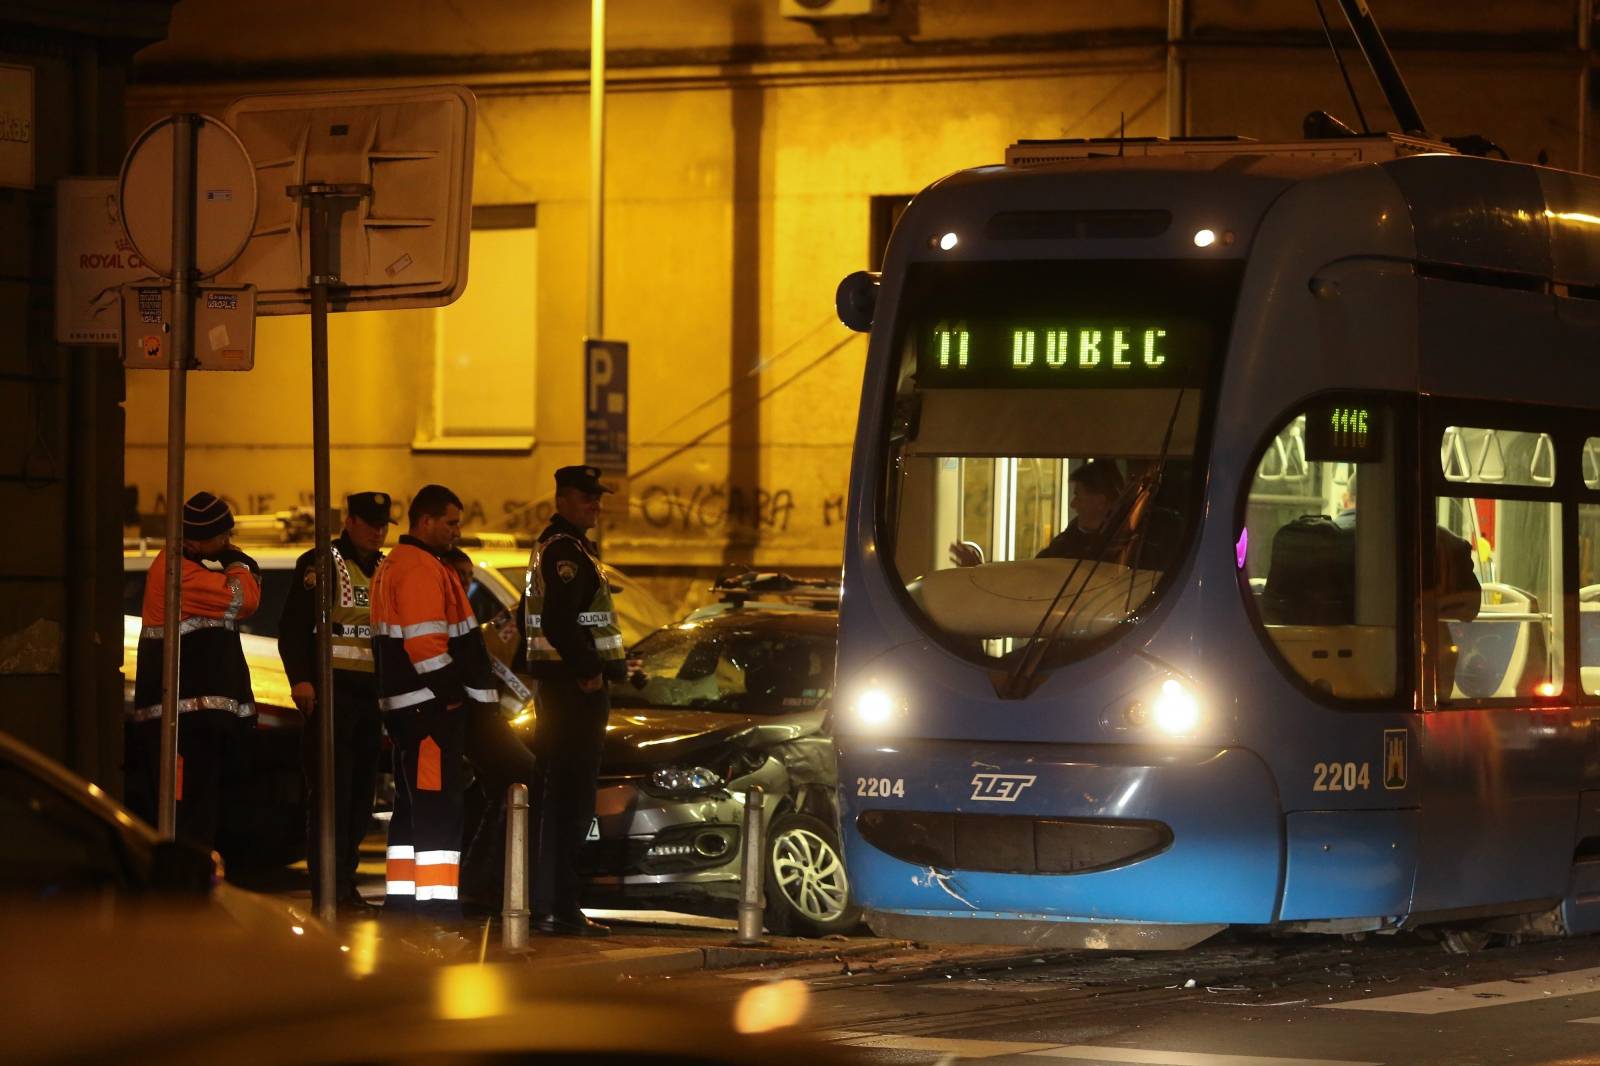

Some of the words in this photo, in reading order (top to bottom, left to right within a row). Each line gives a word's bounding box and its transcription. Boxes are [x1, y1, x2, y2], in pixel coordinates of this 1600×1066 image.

[79, 253, 124, 269] ROYAL
[935, 330, 969, 366] 11
[590, 347, 613, 412] P
[857, 777, 905, 798] 2204
[970, 773, 1037, 802] ZET
[1312, 761, 1371, 792] 2204
